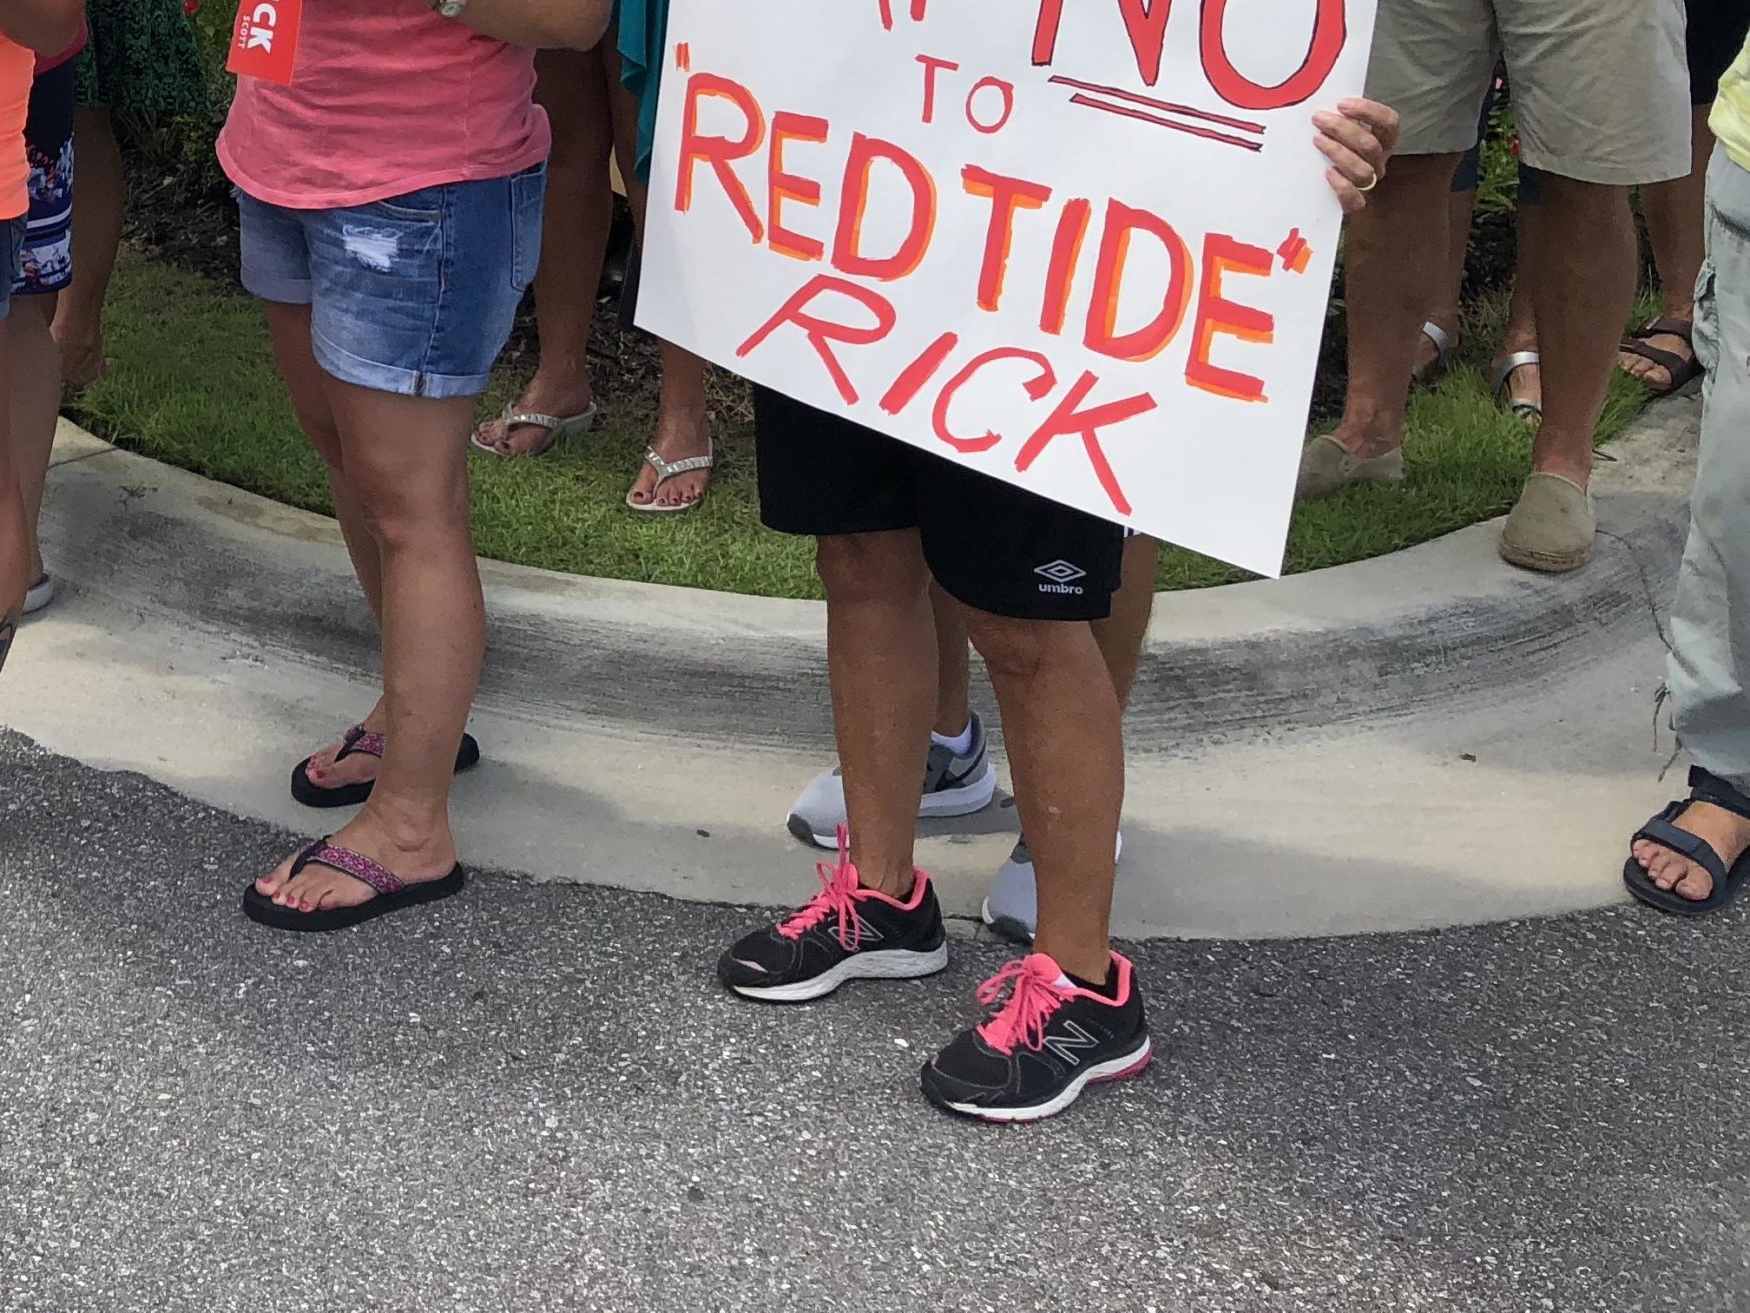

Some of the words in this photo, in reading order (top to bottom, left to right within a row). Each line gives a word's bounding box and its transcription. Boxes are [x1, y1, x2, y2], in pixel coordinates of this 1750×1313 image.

[237, 14, 252, 50] SCOTT
[914, 52, 1015, 135] TO
[734, 272, 1158, 516] RICK
[1038, 583, 1084, 595] umbro
